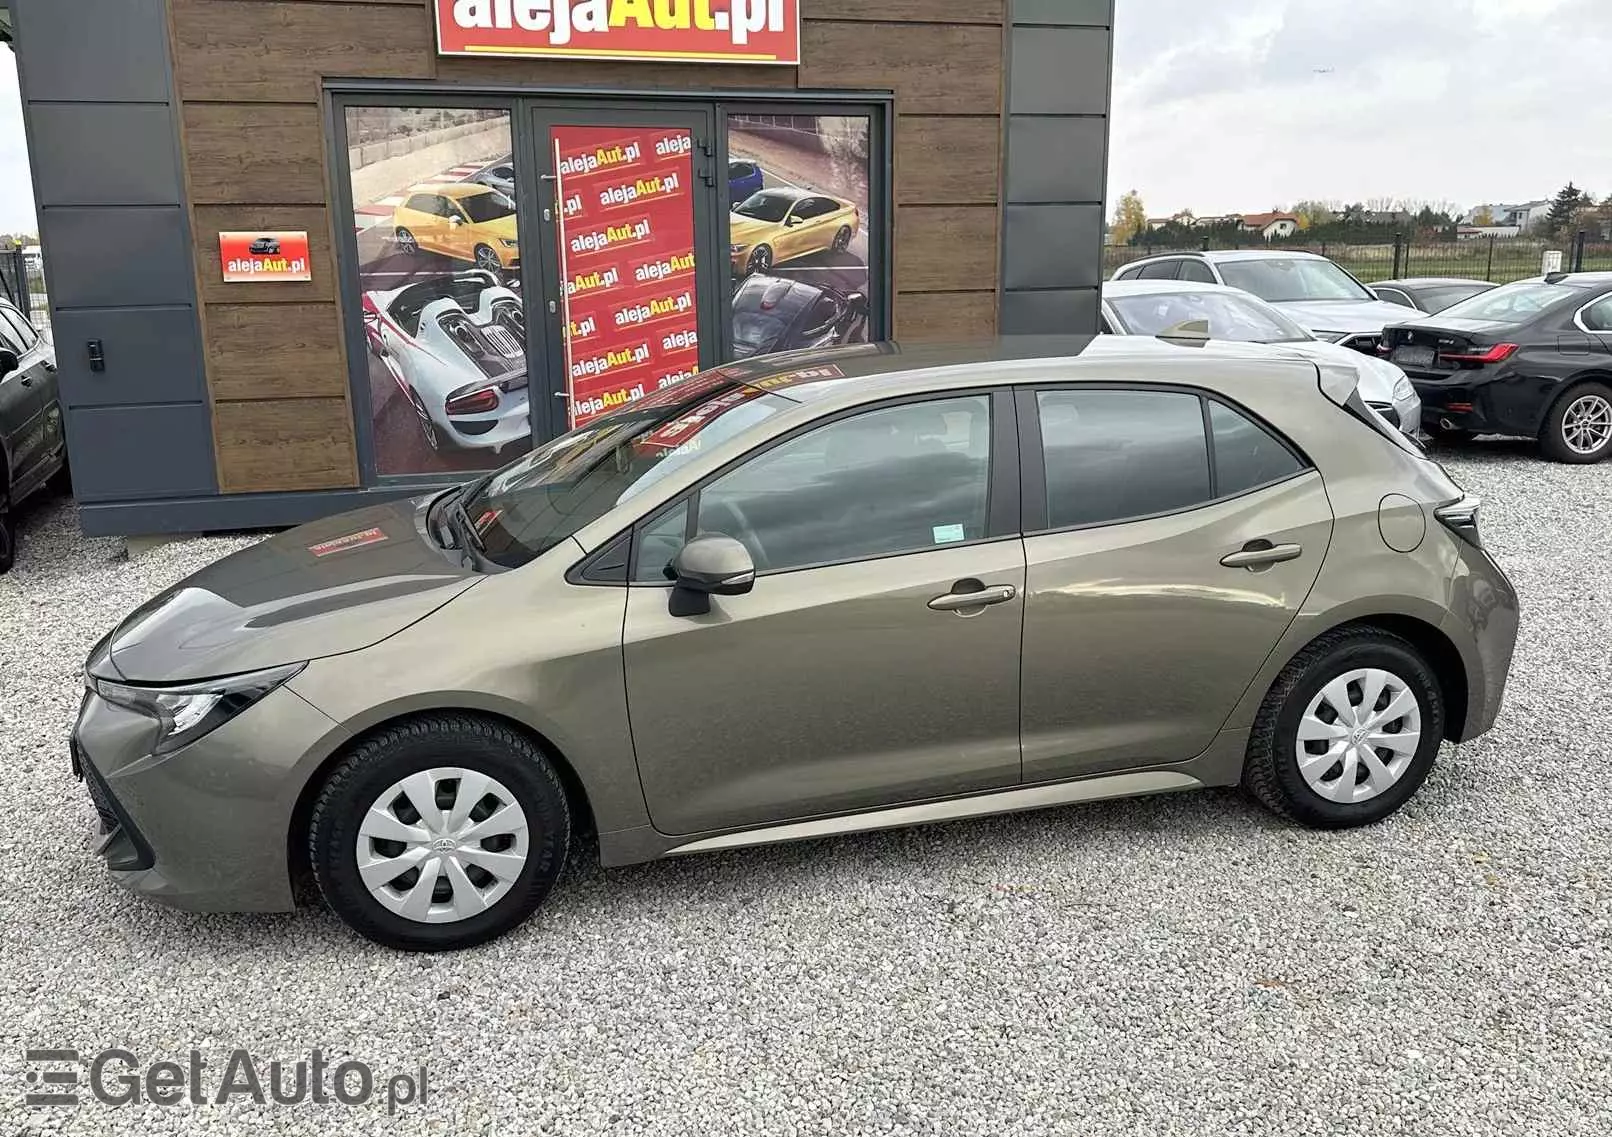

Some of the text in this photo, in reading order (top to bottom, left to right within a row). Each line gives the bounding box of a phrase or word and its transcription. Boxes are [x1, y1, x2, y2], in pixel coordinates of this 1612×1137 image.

[560, 141, 641, 175] alejaAut.pl
[599, 172, 680, 207] alejaAut.pl
[570, 218, 651, 252] alejaAut.pl
[228, 258, 305, 275] alejaAut.pl
[615, 292, 692, 325] alejaAut.pl
[572, 343, 650, 377] alejaAut.pl
